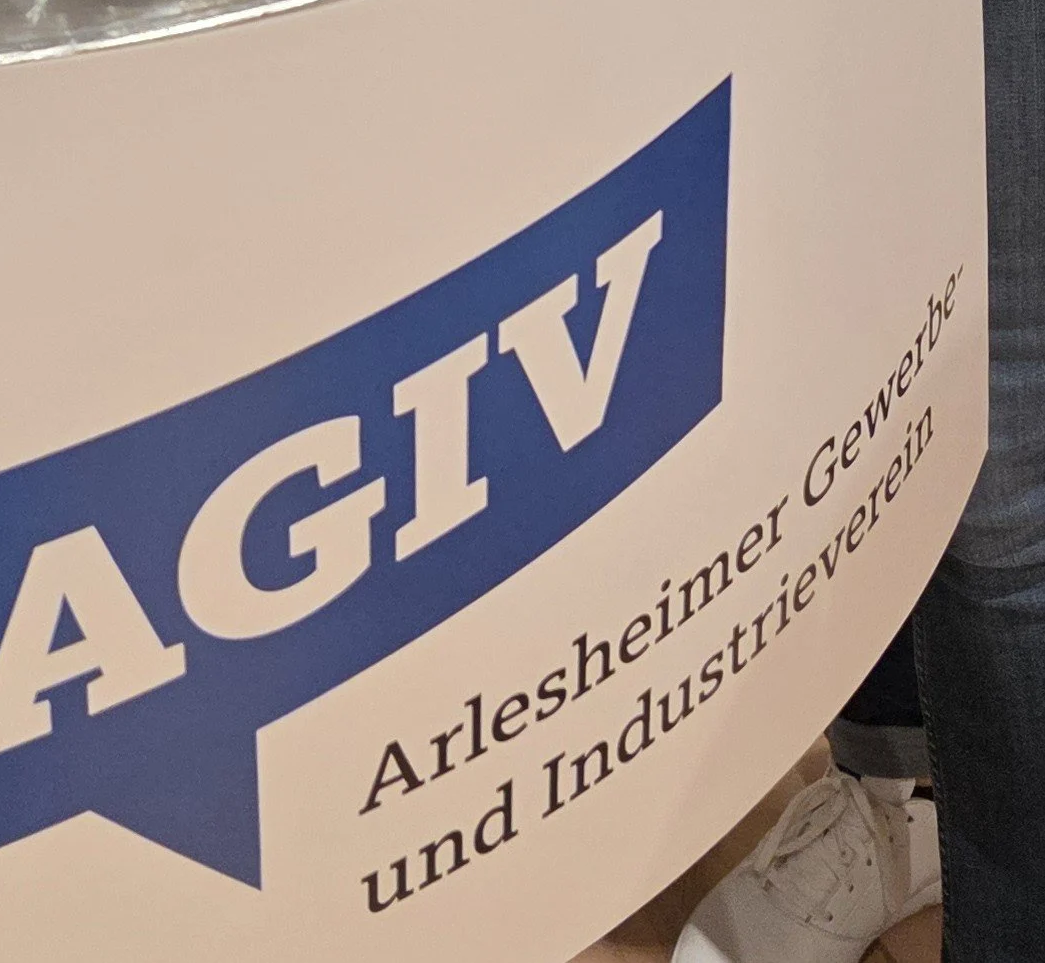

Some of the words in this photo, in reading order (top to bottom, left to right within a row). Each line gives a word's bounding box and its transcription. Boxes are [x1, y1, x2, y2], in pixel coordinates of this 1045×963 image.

[359, 492, 790, 816] Arlesheimer
[803, 262, 964, 507] Gewerbe-
[360, 779, 519, 913] und
[541, 403, 935, 820] Industrieverein
